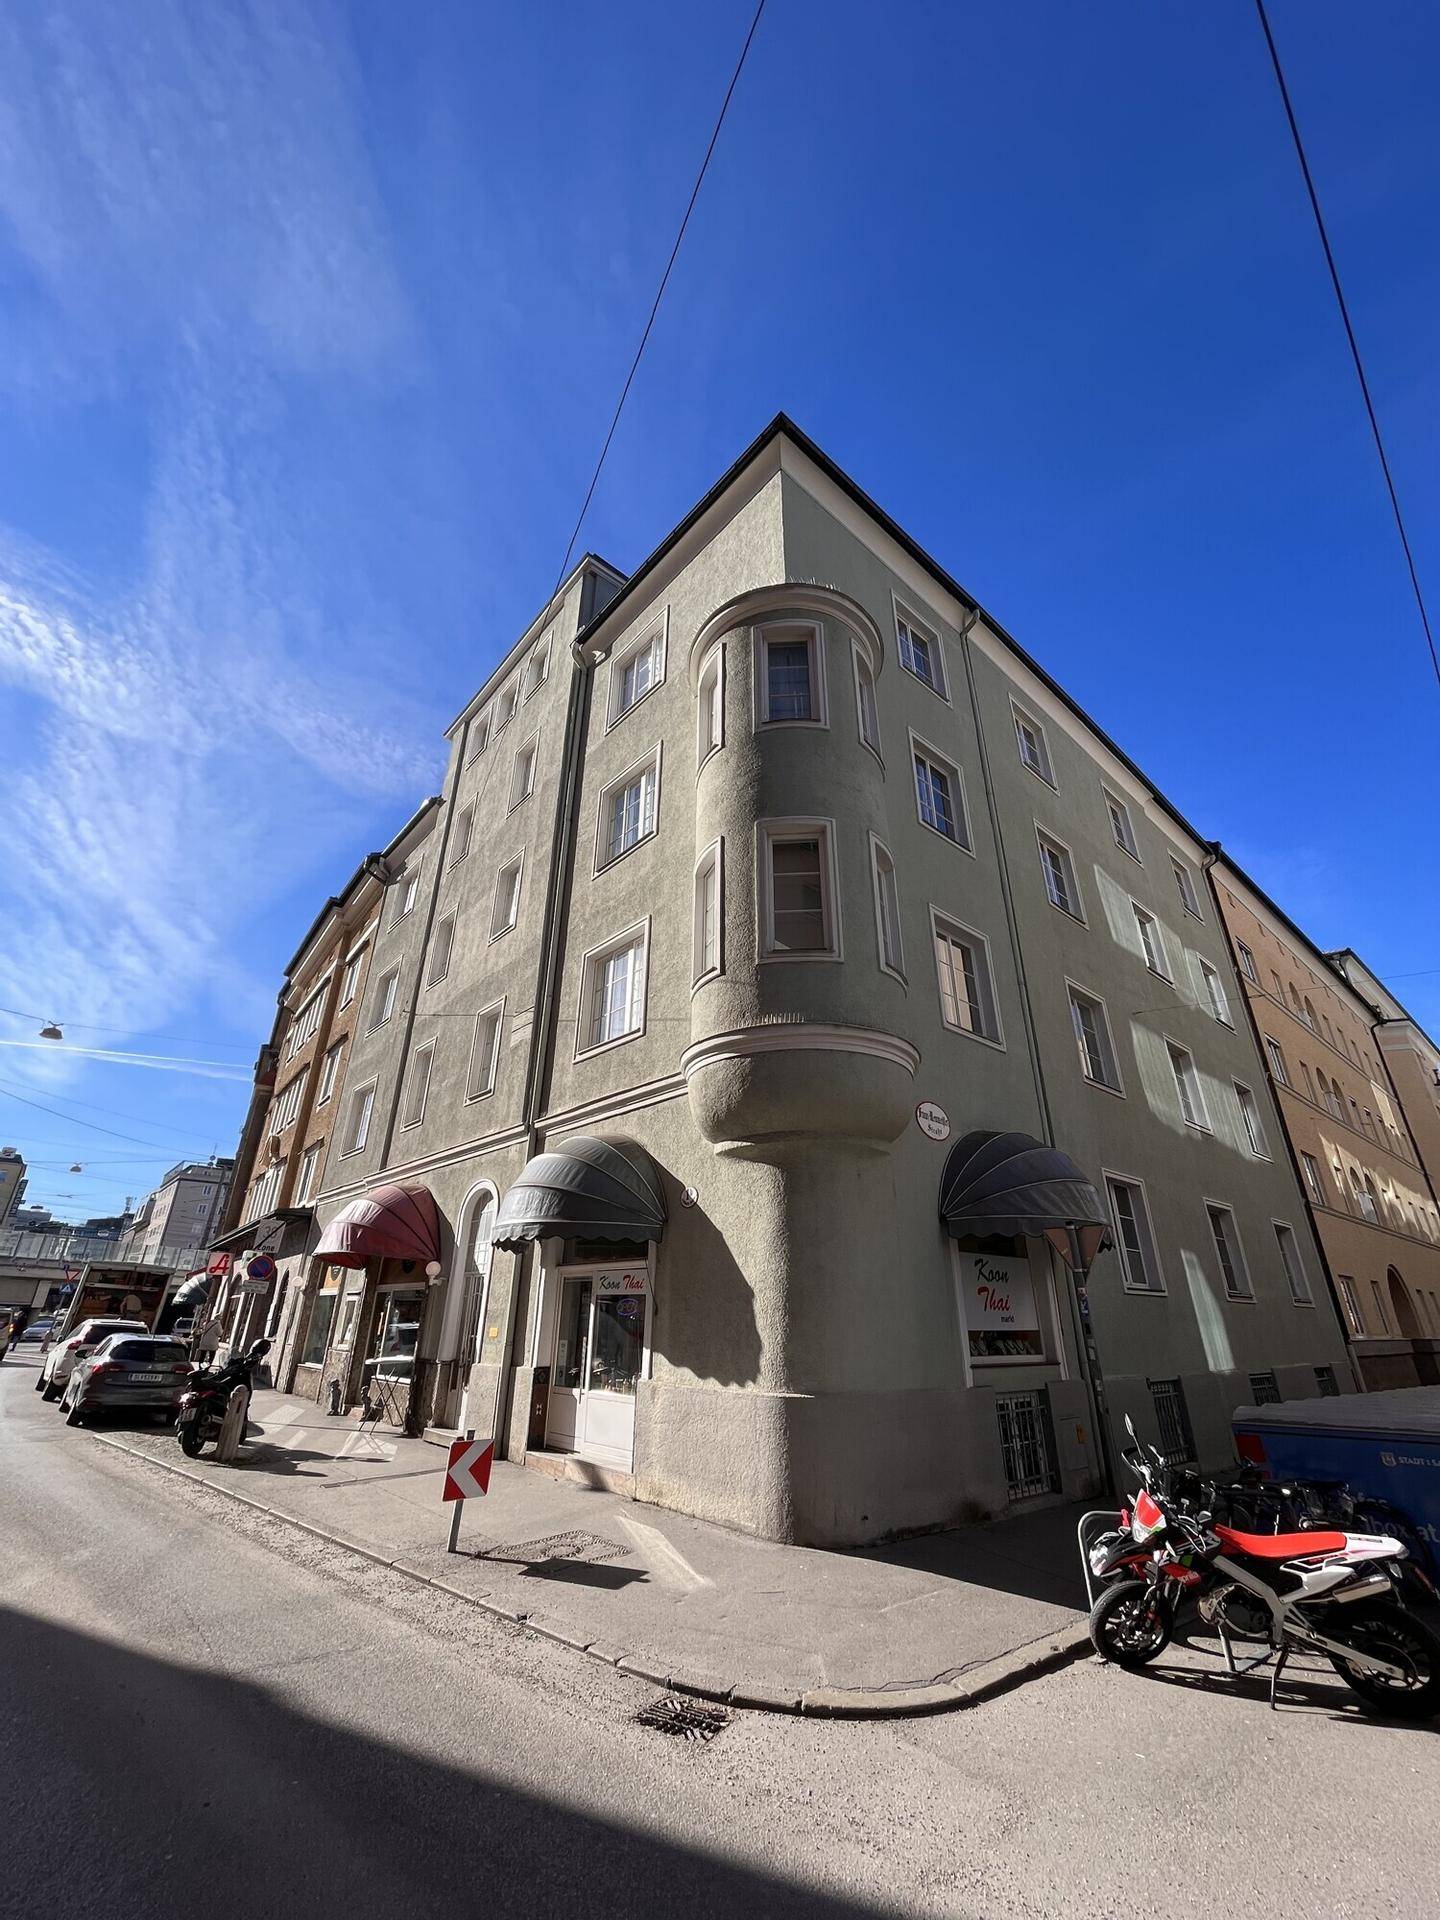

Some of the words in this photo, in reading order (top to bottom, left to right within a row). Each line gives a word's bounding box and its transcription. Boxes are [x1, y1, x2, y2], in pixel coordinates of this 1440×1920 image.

[599, 1275, 621, 1290] Koon
[623, 1274, 645, 1290] Thai
[974, 1258, 1009, 1283] Koon
[977, 1286, 1011, 1312] Thai
